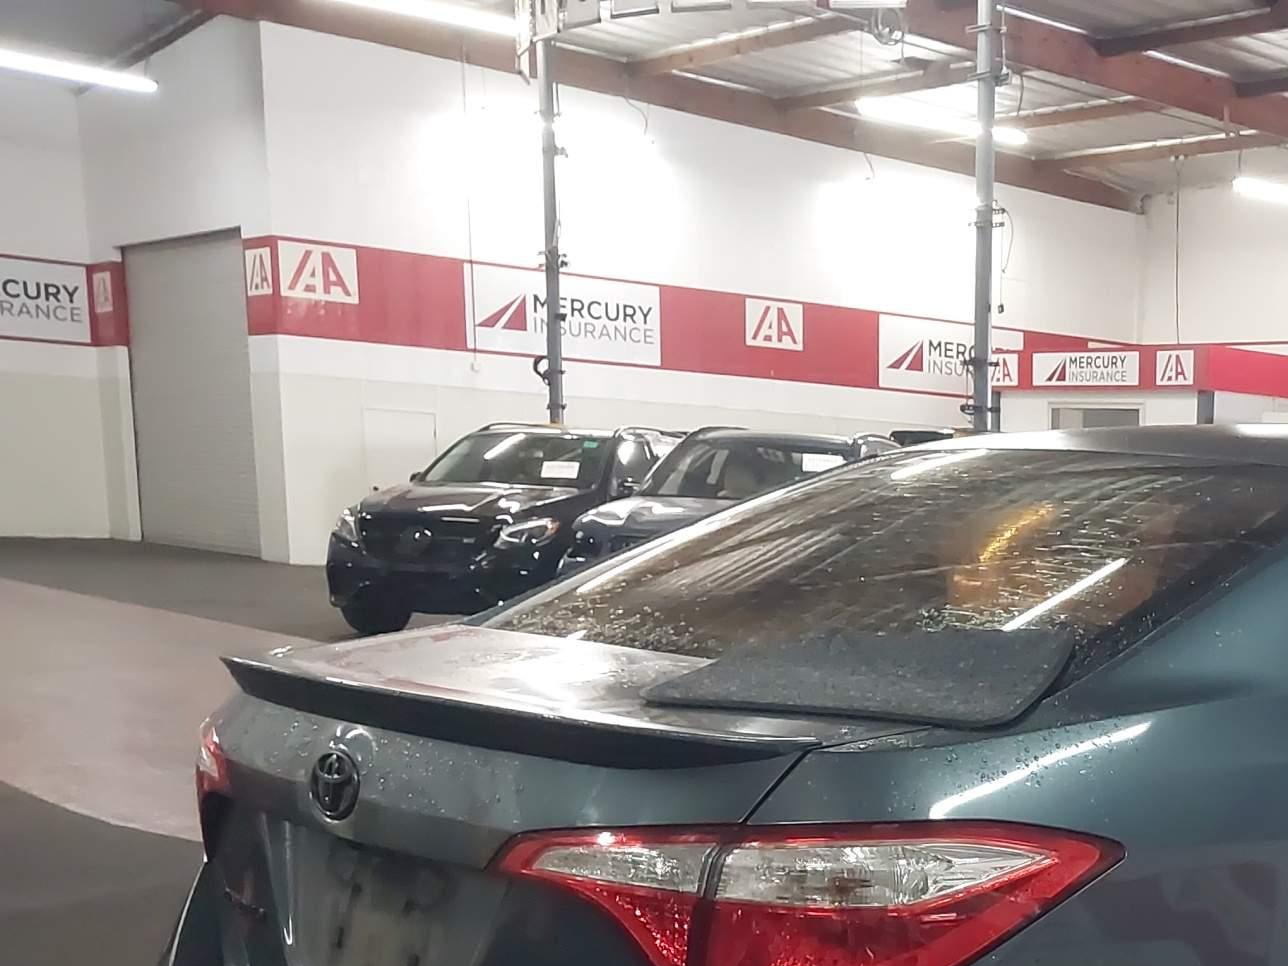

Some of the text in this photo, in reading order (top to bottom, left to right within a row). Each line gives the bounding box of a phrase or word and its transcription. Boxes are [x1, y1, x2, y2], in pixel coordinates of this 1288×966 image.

[0, 278, 79, 304] CURY
[0, 300, 82, 323] RANCE
[533, 293, 652, 325] MERCURY
[1068, 355, 1127, 369] MERCURY
[1068, 370, 1127, 382] INSURANCE
